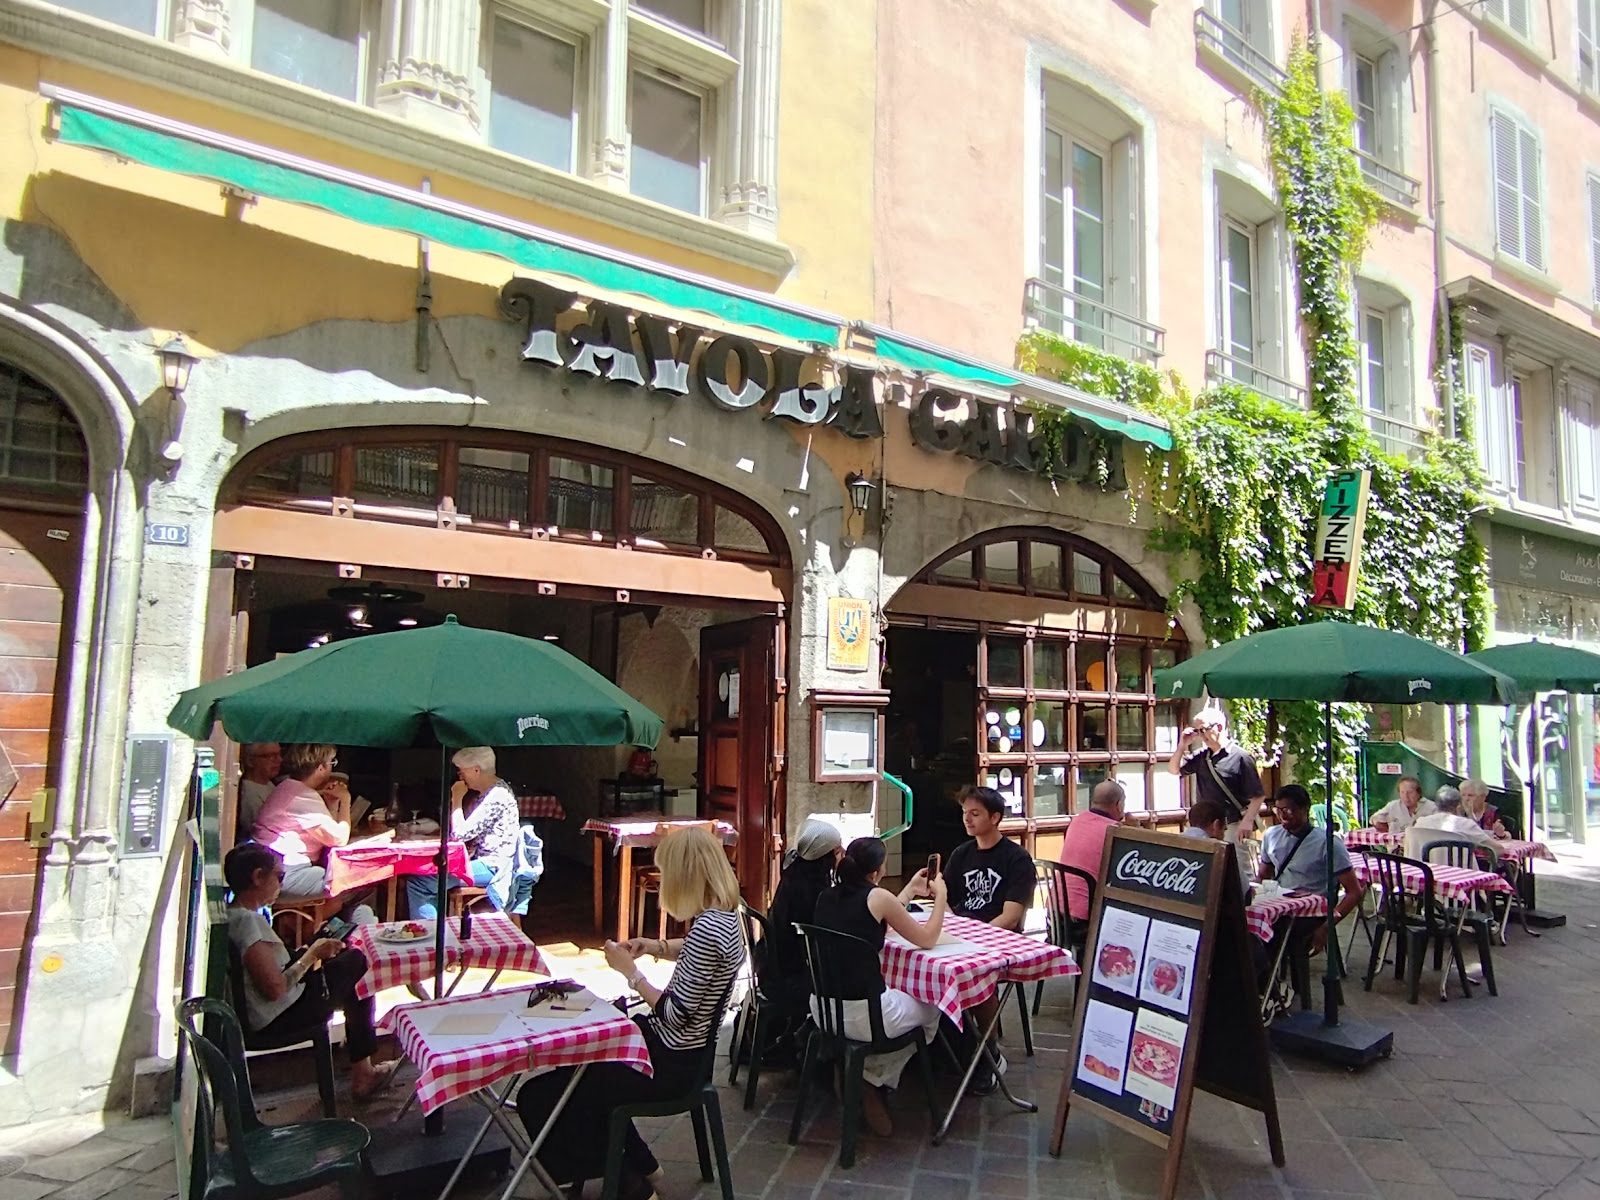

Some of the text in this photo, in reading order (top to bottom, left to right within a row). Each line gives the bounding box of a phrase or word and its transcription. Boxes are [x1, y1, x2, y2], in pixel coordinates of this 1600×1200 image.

[499, 272, 884, 440] TAVOLA
[158, 526, 179, 541] 10
[1319, 472, 1356, 605] PIZZERIA
[1116, 850, 1205, 894] Coca-Cola
